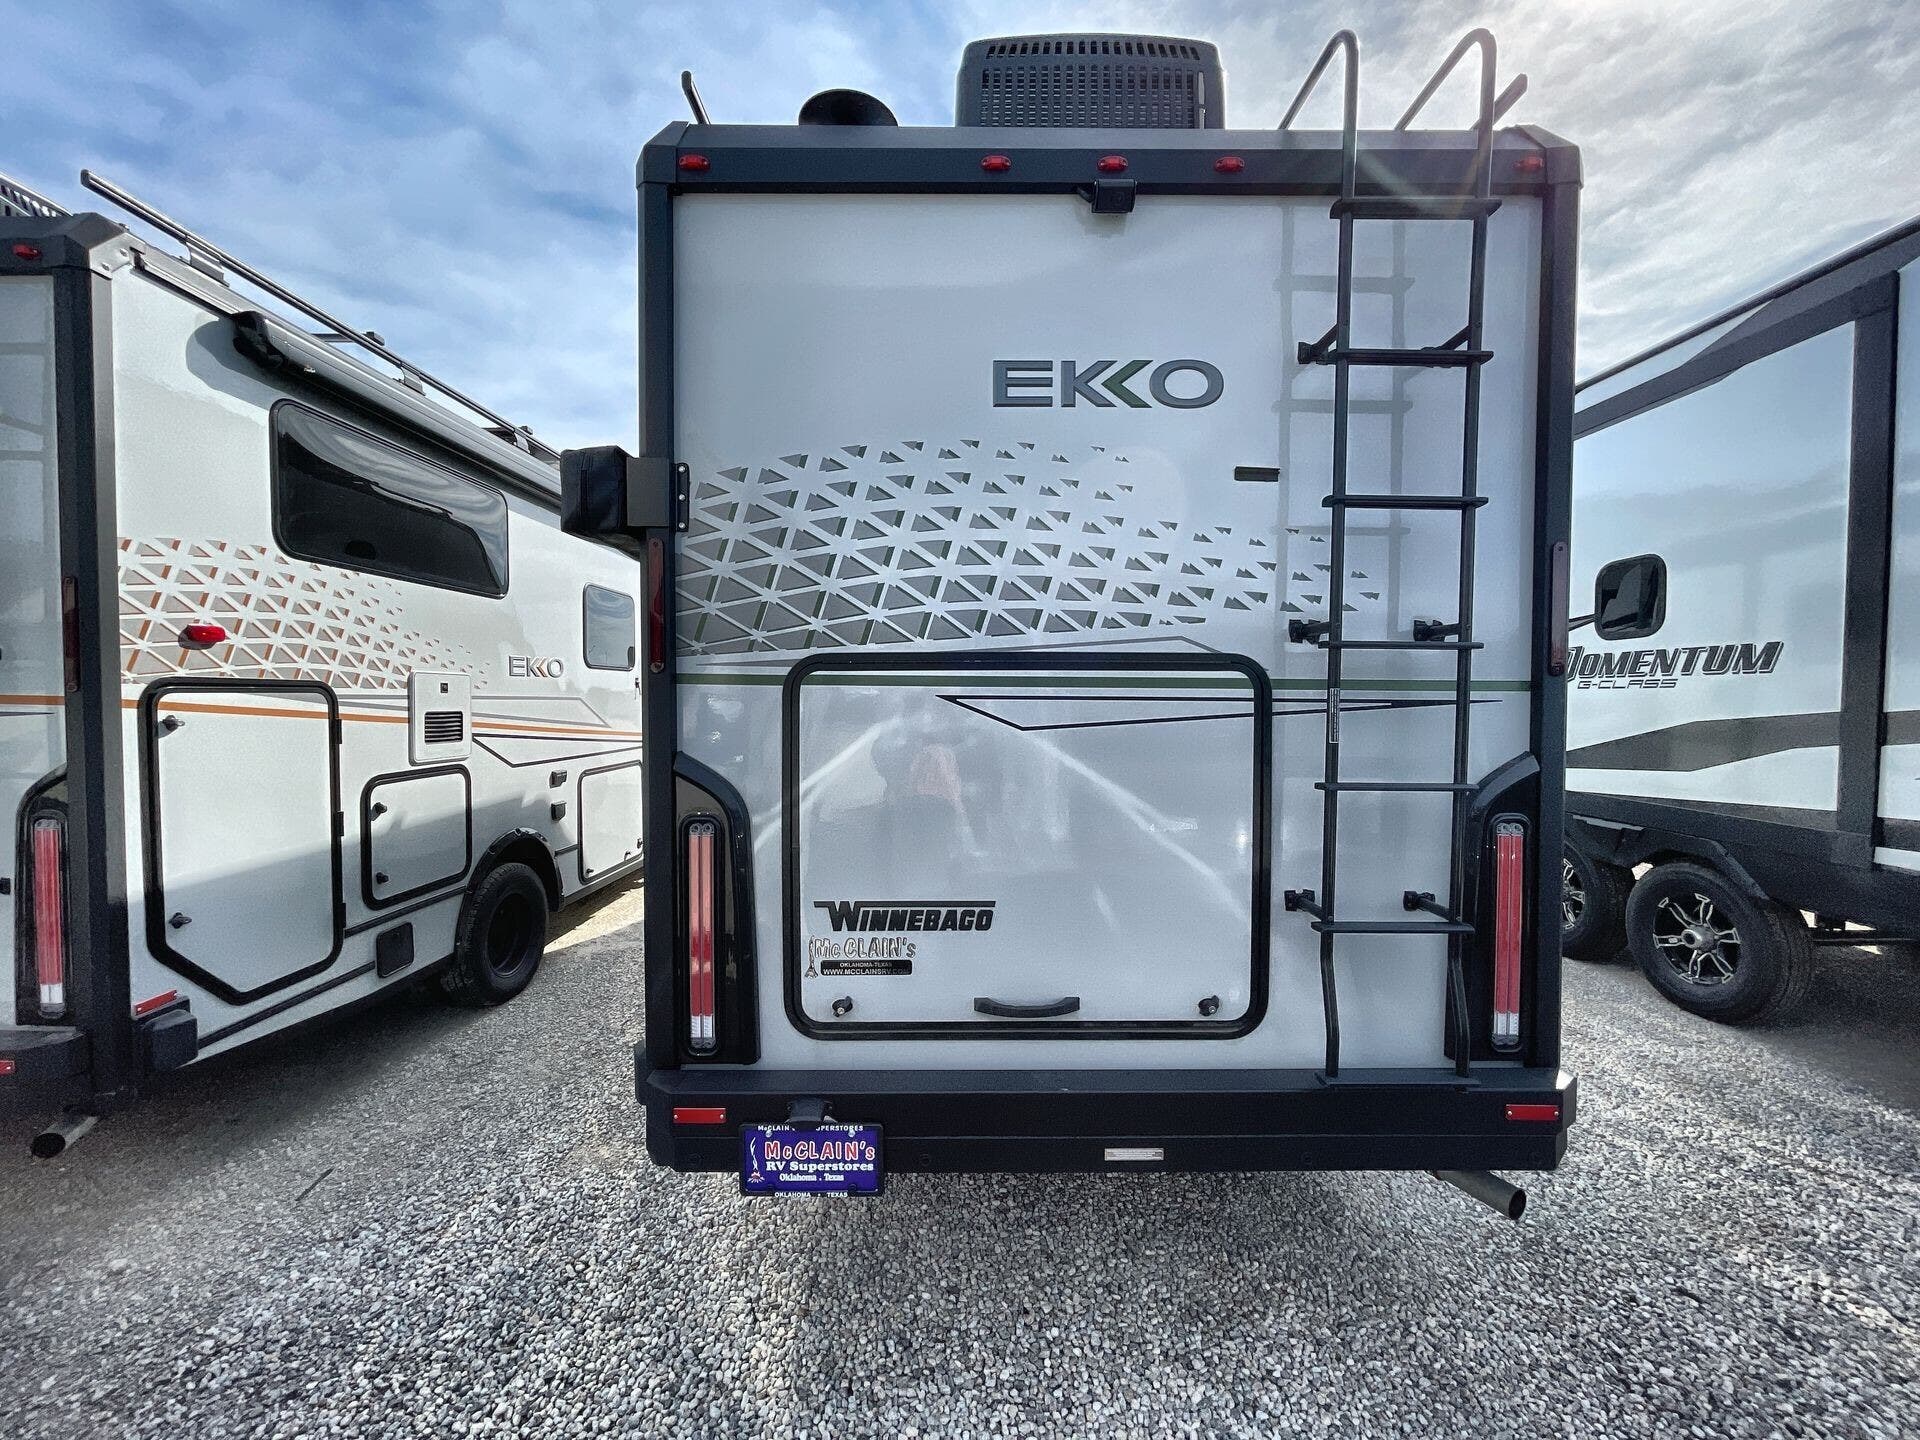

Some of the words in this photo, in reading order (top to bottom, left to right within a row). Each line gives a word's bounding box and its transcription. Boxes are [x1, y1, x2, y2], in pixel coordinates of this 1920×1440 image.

[993, 359, 1224, 409] EKKO
[508, 655, 564, 678] EKKO
[1577, 679, 1678, 689] G-CLASS
[813, 901, 996, 932] WINNEBAGO
[764, 1140, 876, 1160] McCLAIN's
[766, 1161, 786, 1171] RV
[789, 1161, 874, 1173] Superstores
[779, 1173, 817, 1181] Oklahoma
[823, 1173, 845, 1181] Texas
